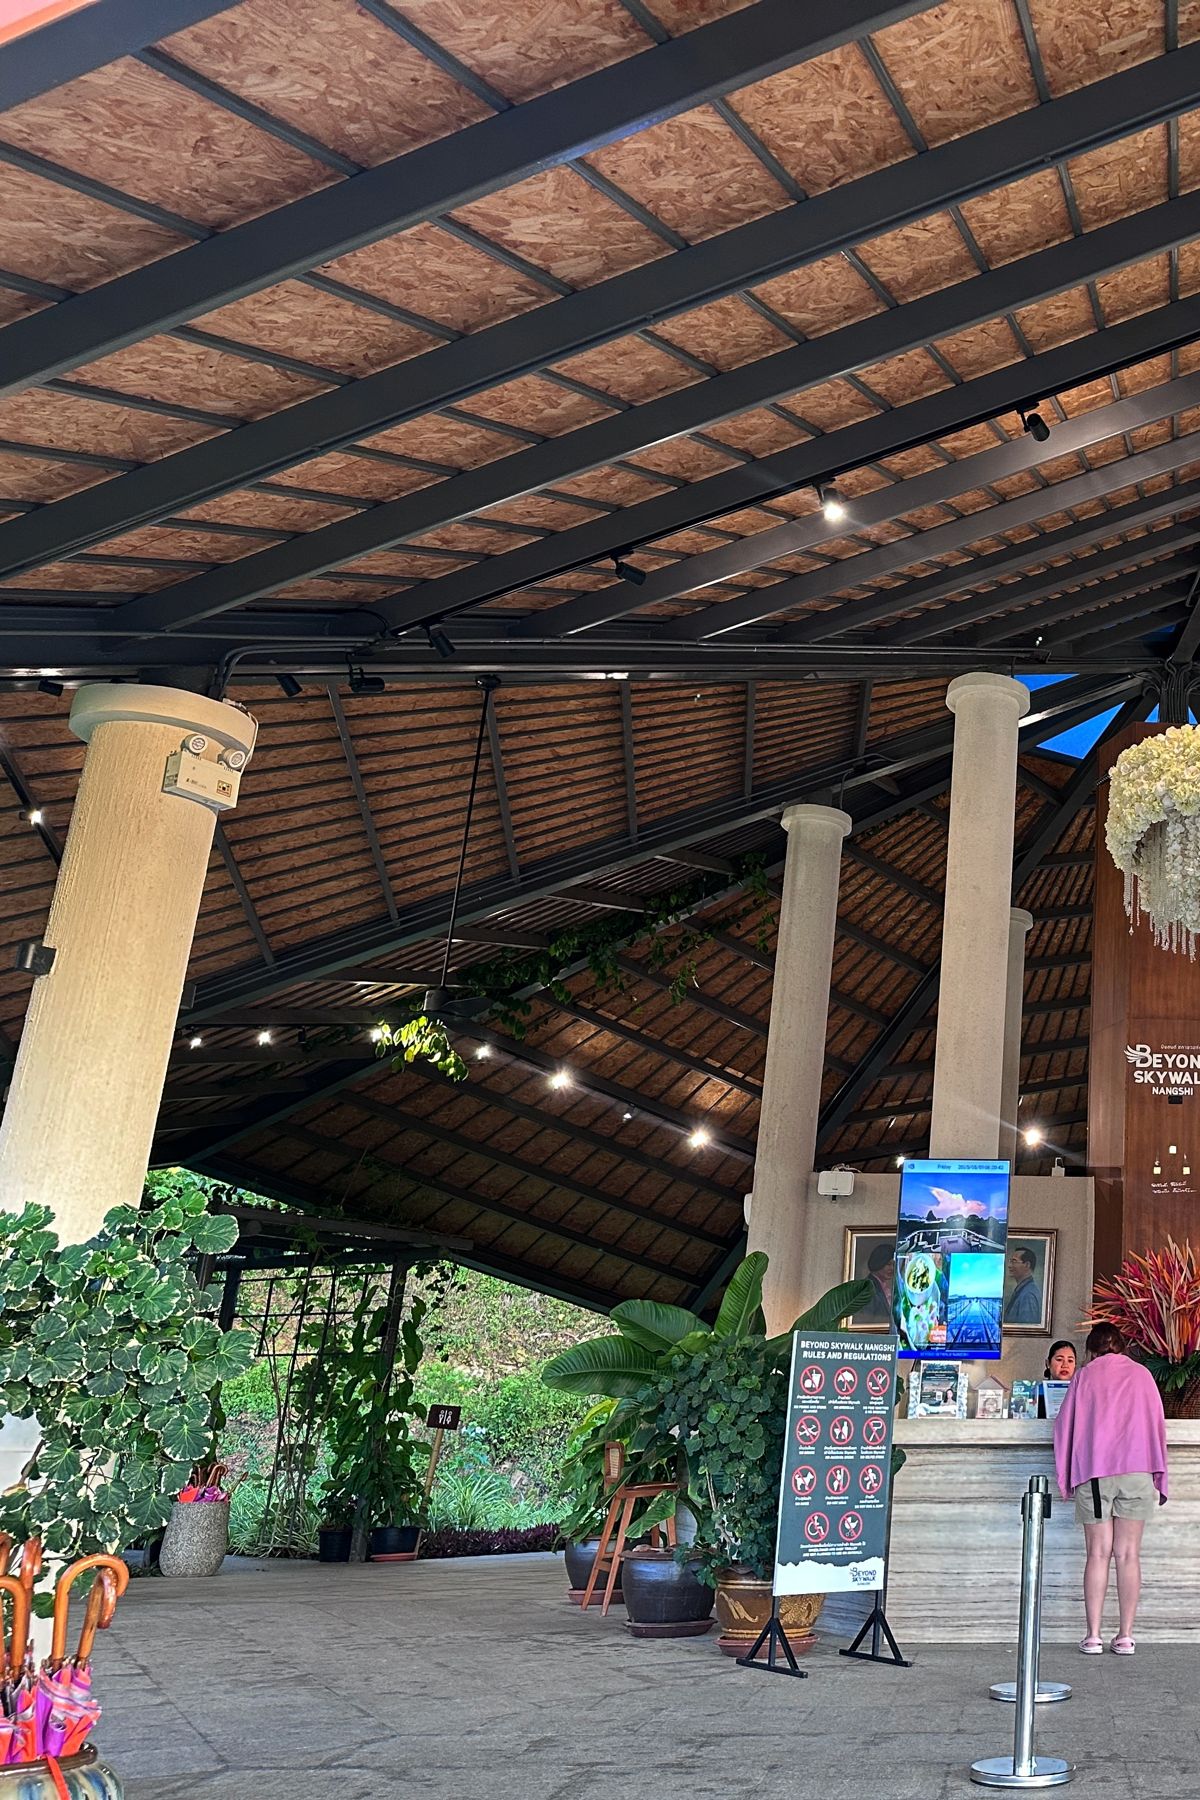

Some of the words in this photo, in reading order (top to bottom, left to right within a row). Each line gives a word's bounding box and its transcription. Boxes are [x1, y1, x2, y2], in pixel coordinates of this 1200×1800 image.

[1152, 1086, 1194, 1096] NANGSHI
[800, 1340, 829, 1349] BEYOND
[830, 1341, 863, 1350] SKYWALK
[864, 1343, 895, 1352] NANGSHI
[802, 1350, 826, 1359] RULES
[826, 1351, 842, 1360] AND
[843, 1352, 892, 1361] REGULATIONS
[850, 1567, 877, 1577] BEYOND
